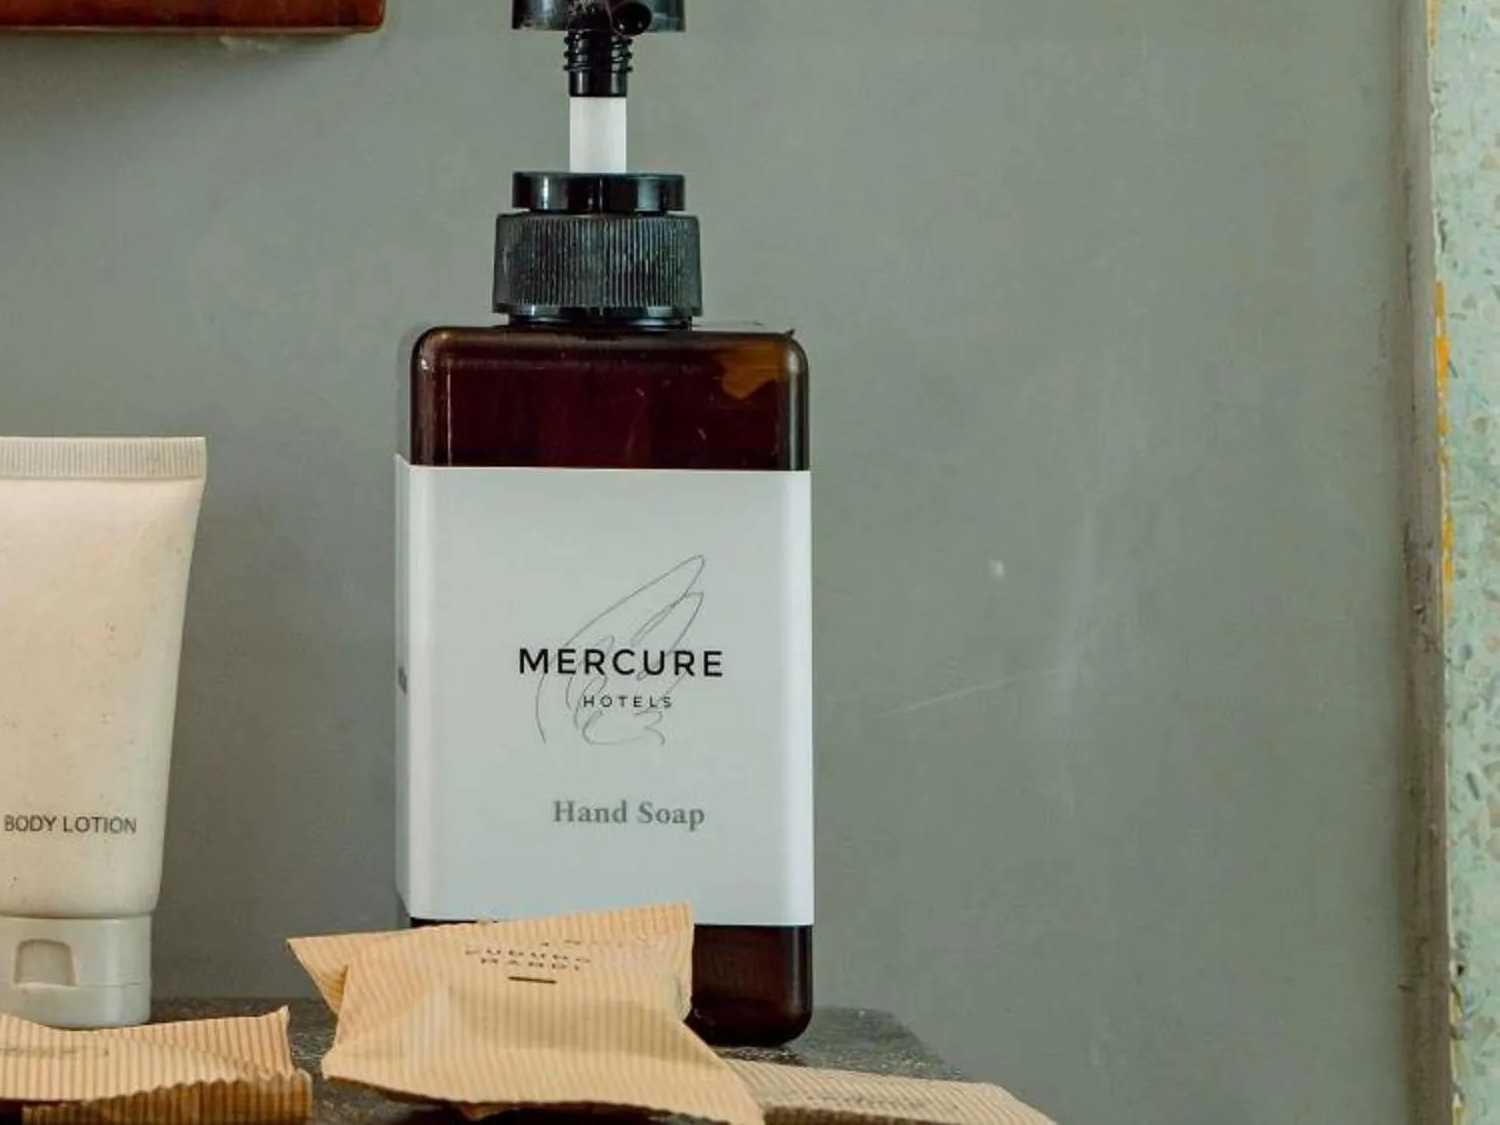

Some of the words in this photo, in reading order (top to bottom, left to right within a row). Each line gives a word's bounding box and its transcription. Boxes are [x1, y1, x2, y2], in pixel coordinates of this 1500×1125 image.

[519, 647, 723, 677] MERCURE
[583, 695, 672, 708] HOTELS
[4, 814, 57, 833] BODY
[62, 815, 137, 834] LOTION
[554, 800, 628, 824] Hand
[638, 802, 705, 832] Soap
